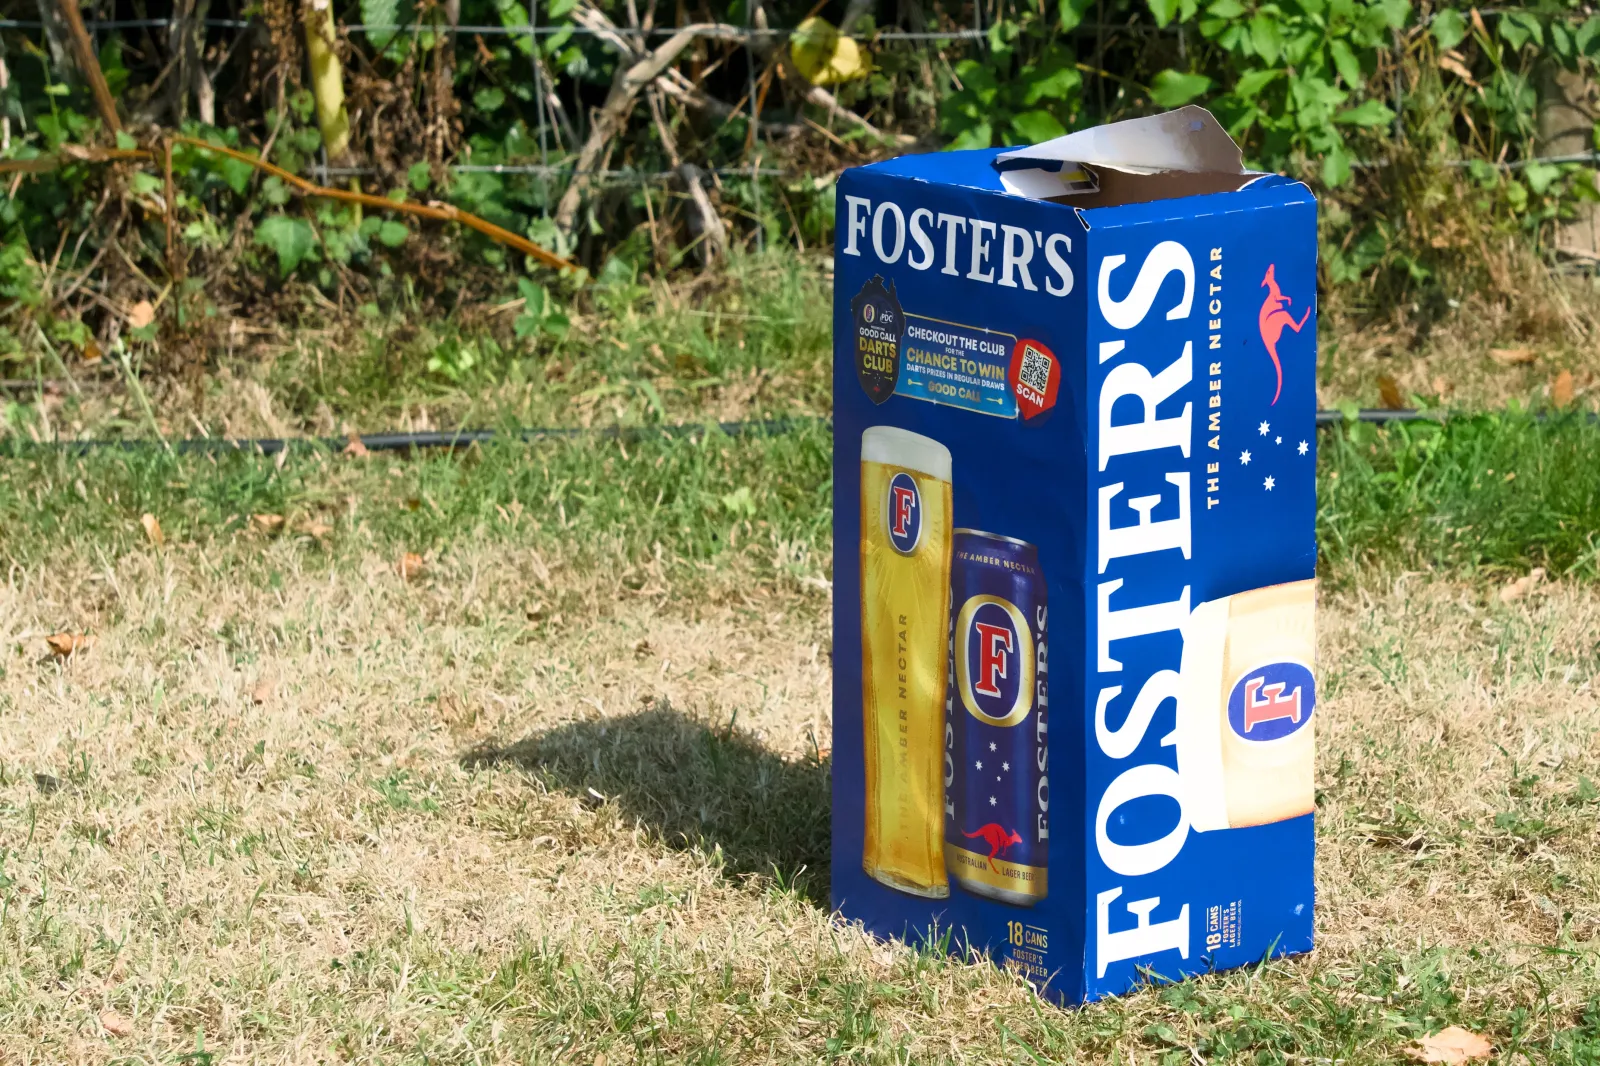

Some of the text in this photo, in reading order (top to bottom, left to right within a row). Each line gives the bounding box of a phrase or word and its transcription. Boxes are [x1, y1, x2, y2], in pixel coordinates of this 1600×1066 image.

[843, 195, 1074, 297] FOSTER'S
[860, 327, 879, 339] GOOD
[880, 332, 896, 342] CALL
[860, 337, 897, 359] DARTS
[908, 326, 1005, 356] CHECKOUT THE CLUB
[863, 354, 893, 373] CLUB
[907, 347, 1005, 381] CHANCE TO WIN
[945, 347, 965, 357] FOR THE
[907, 363, 1005, 391] DARTS PRIZES IN REGULAR DRAWS
[1207, 247, 1223, 510] THE AMBER NECTAR
[928, 381, 981, 403] GOOD CALL
[1016, 383, 1044, 408] SCAN
[893, 486, 915, 538] F
[970, 554, 1000, 566] AMBER
[1003, 560, 1036, 575] NECTAR
[1095, 240, 1196, 979] FOSTER'S
[898, 613, 908, 700] NECTAR
[975, 622, 1014, 698] F
[1244, 675, 1302, 734] F
[1002, 867, 1020, 878] LAGER
[1007, 920, 1048, 949] 18 CANS
[1206, 905, 1222, 953] 18 CANS
[1012, 948, 1043, 965] FOSTER'S
[1031, 964, 1048, 978] BEER
